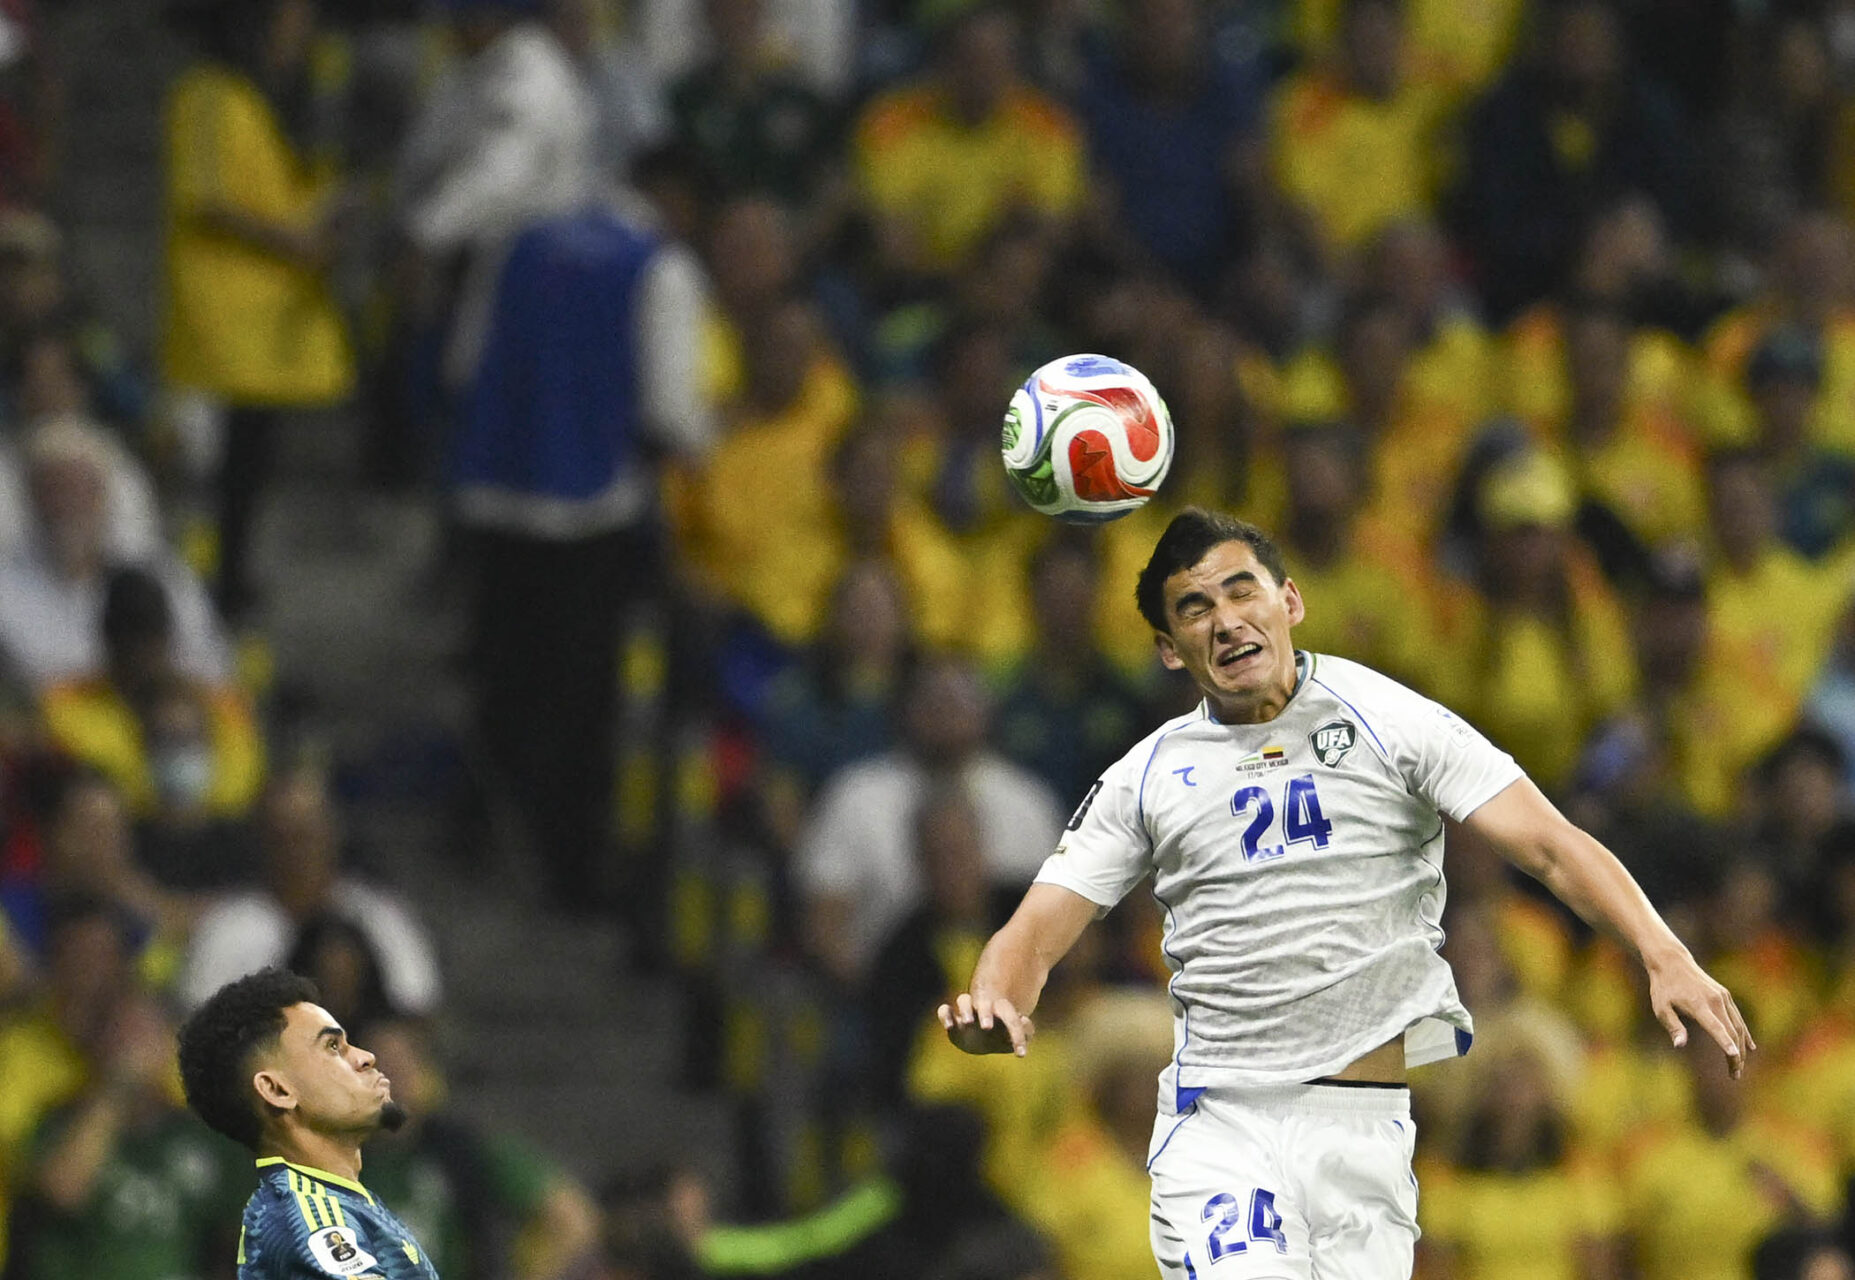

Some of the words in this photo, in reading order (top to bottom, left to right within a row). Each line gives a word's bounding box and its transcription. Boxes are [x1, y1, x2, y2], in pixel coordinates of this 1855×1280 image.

[1317, 727, 1351, 750] UFA
[1231, 774, 1332, 863] 24
[1201, 1187, 1287, 1266] 24
